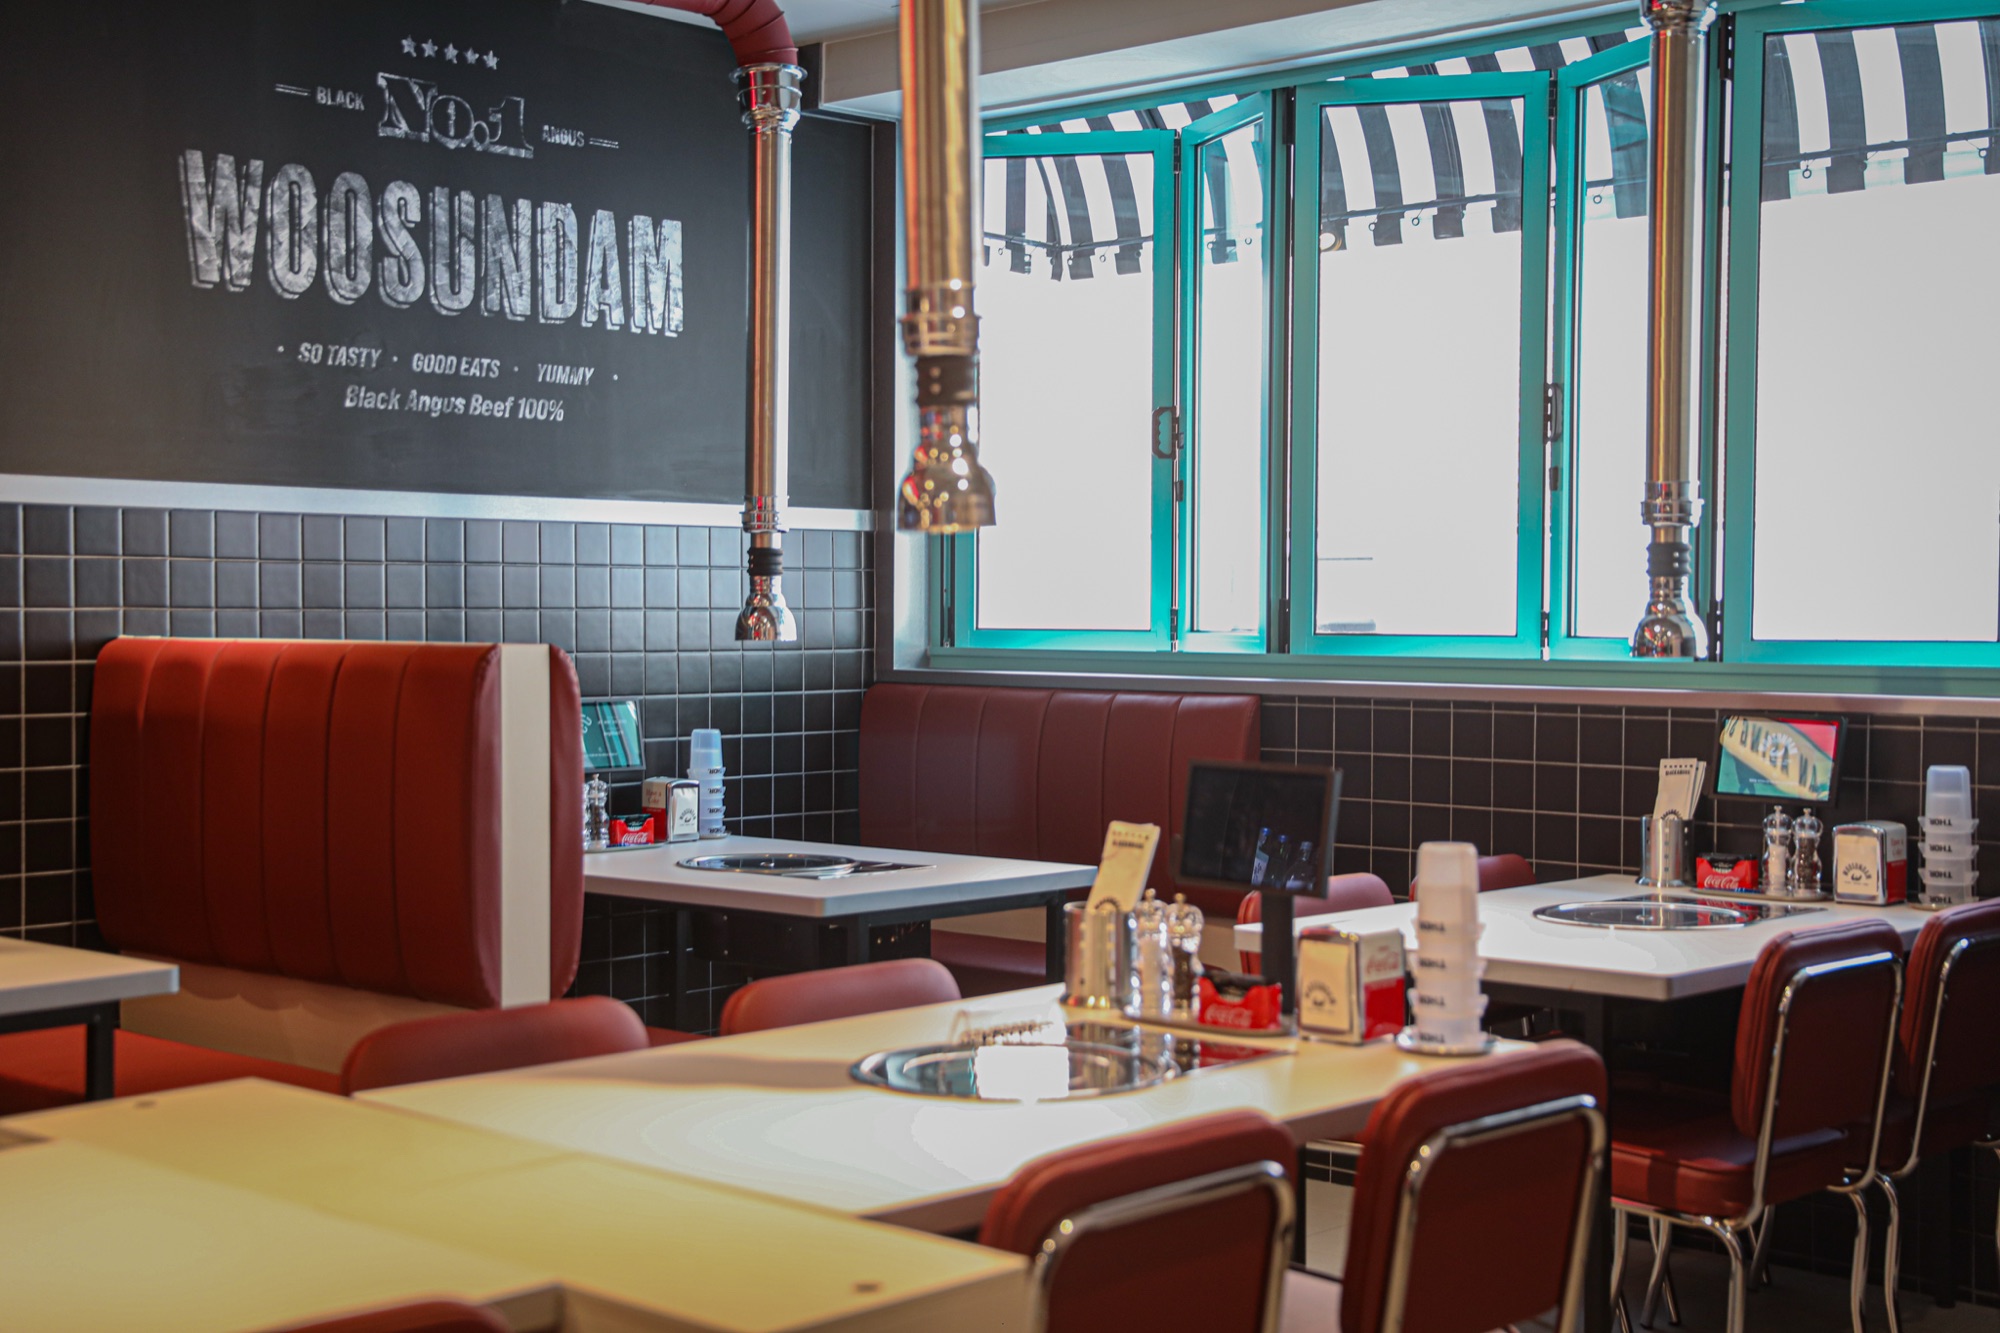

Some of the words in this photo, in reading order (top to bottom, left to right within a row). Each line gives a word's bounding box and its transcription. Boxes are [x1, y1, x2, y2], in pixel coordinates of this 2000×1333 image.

[316, 86, 365, 111] BLACK
[376, 71, 534, 159] No.1
[541, 124, 585, 147] ANGUS
[178, 148, 684, 339] WOOSUNDAM
[297, 342, 323, 364] SO
[327, 345, 382, 368] TASTY
[412, 352, 457, 376] GOOD
[459, 356, 501, 379] EATS
[536, 363, 595, 386] YUMMY
[344, 384, 401, 410] Black
[404, 389, 466, 417] Angus
[469, 393, 515, 418] Beef
[517, 397, 564, 422] 100%
[1929, 844, 1952, 852] THOR
[1929, 871, 1952, 879] THOR
